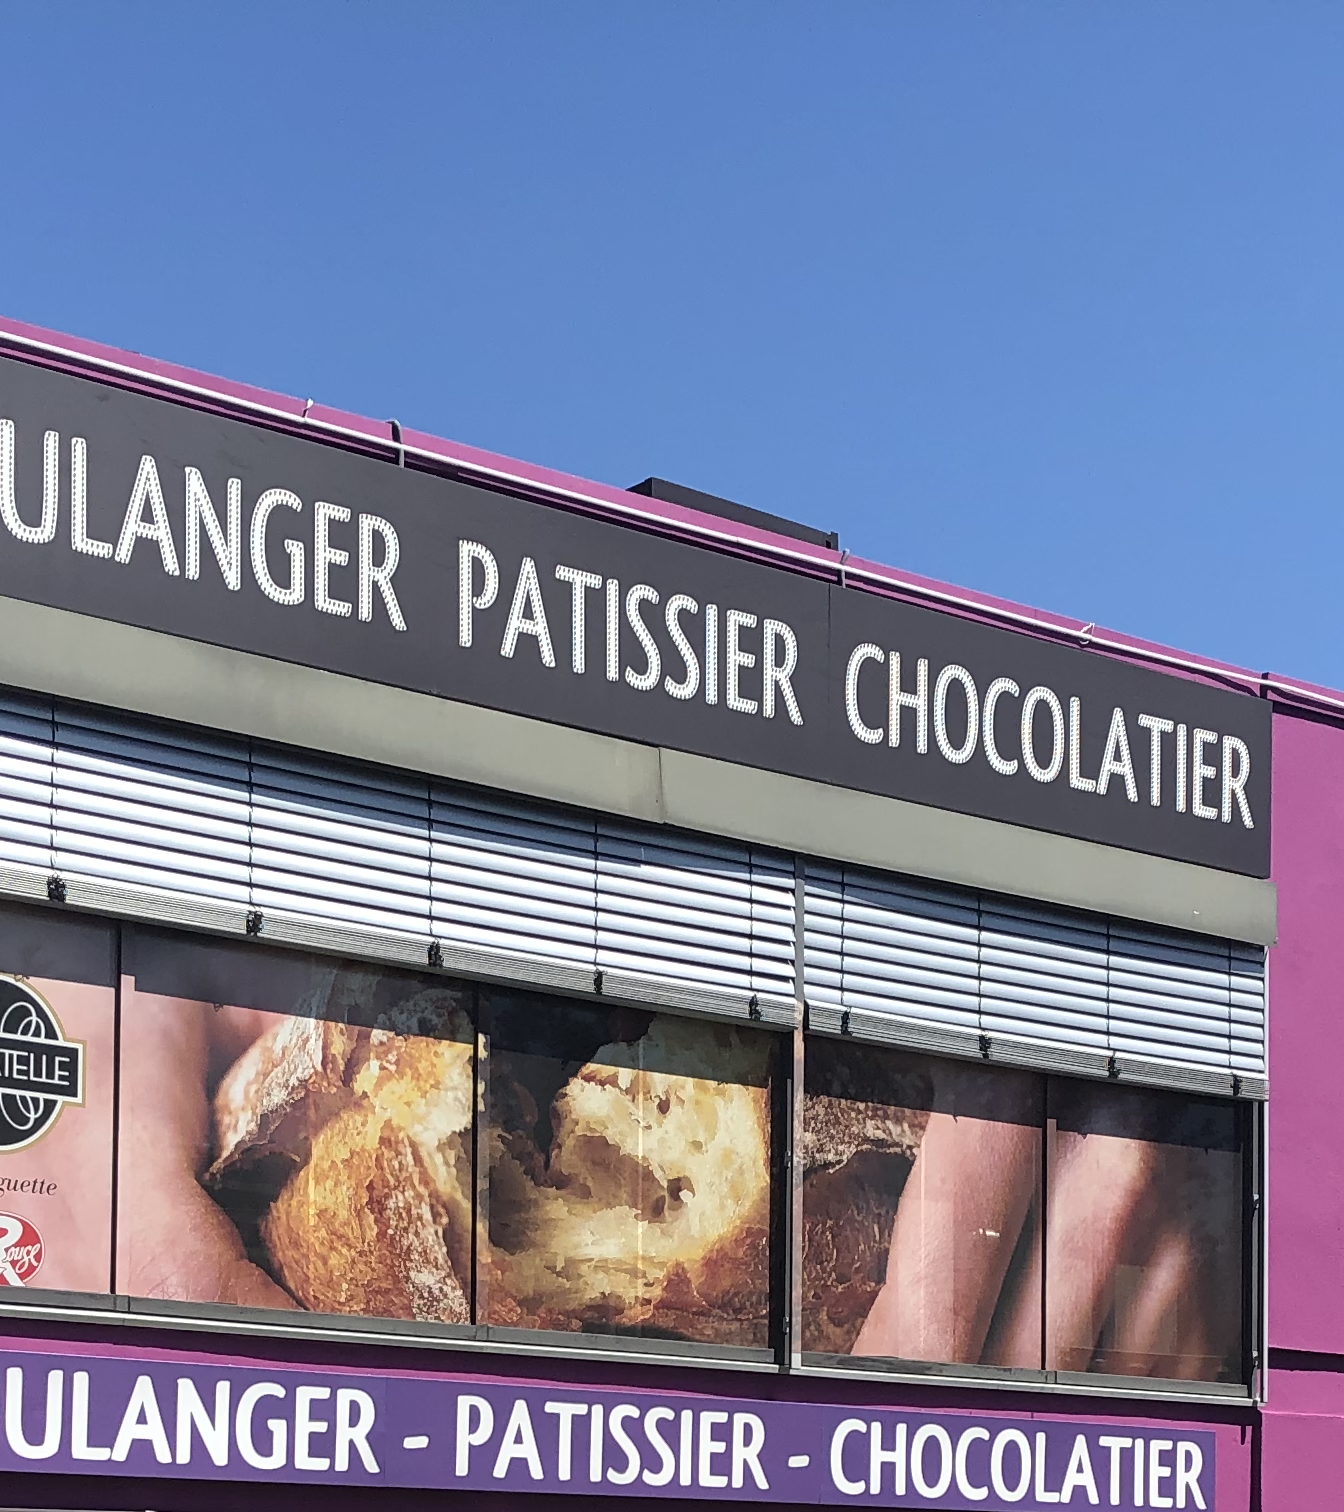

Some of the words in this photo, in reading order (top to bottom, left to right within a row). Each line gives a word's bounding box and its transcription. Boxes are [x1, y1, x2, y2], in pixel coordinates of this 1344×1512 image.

[458, 539, 804, 726] PATISSIER
[845, 643, 1255, 829] CHOCOLATIER
[455, 1394, 769, 1490] PATISSIER
[830, 1418, 1207, 1511] CHOCOLATIER
